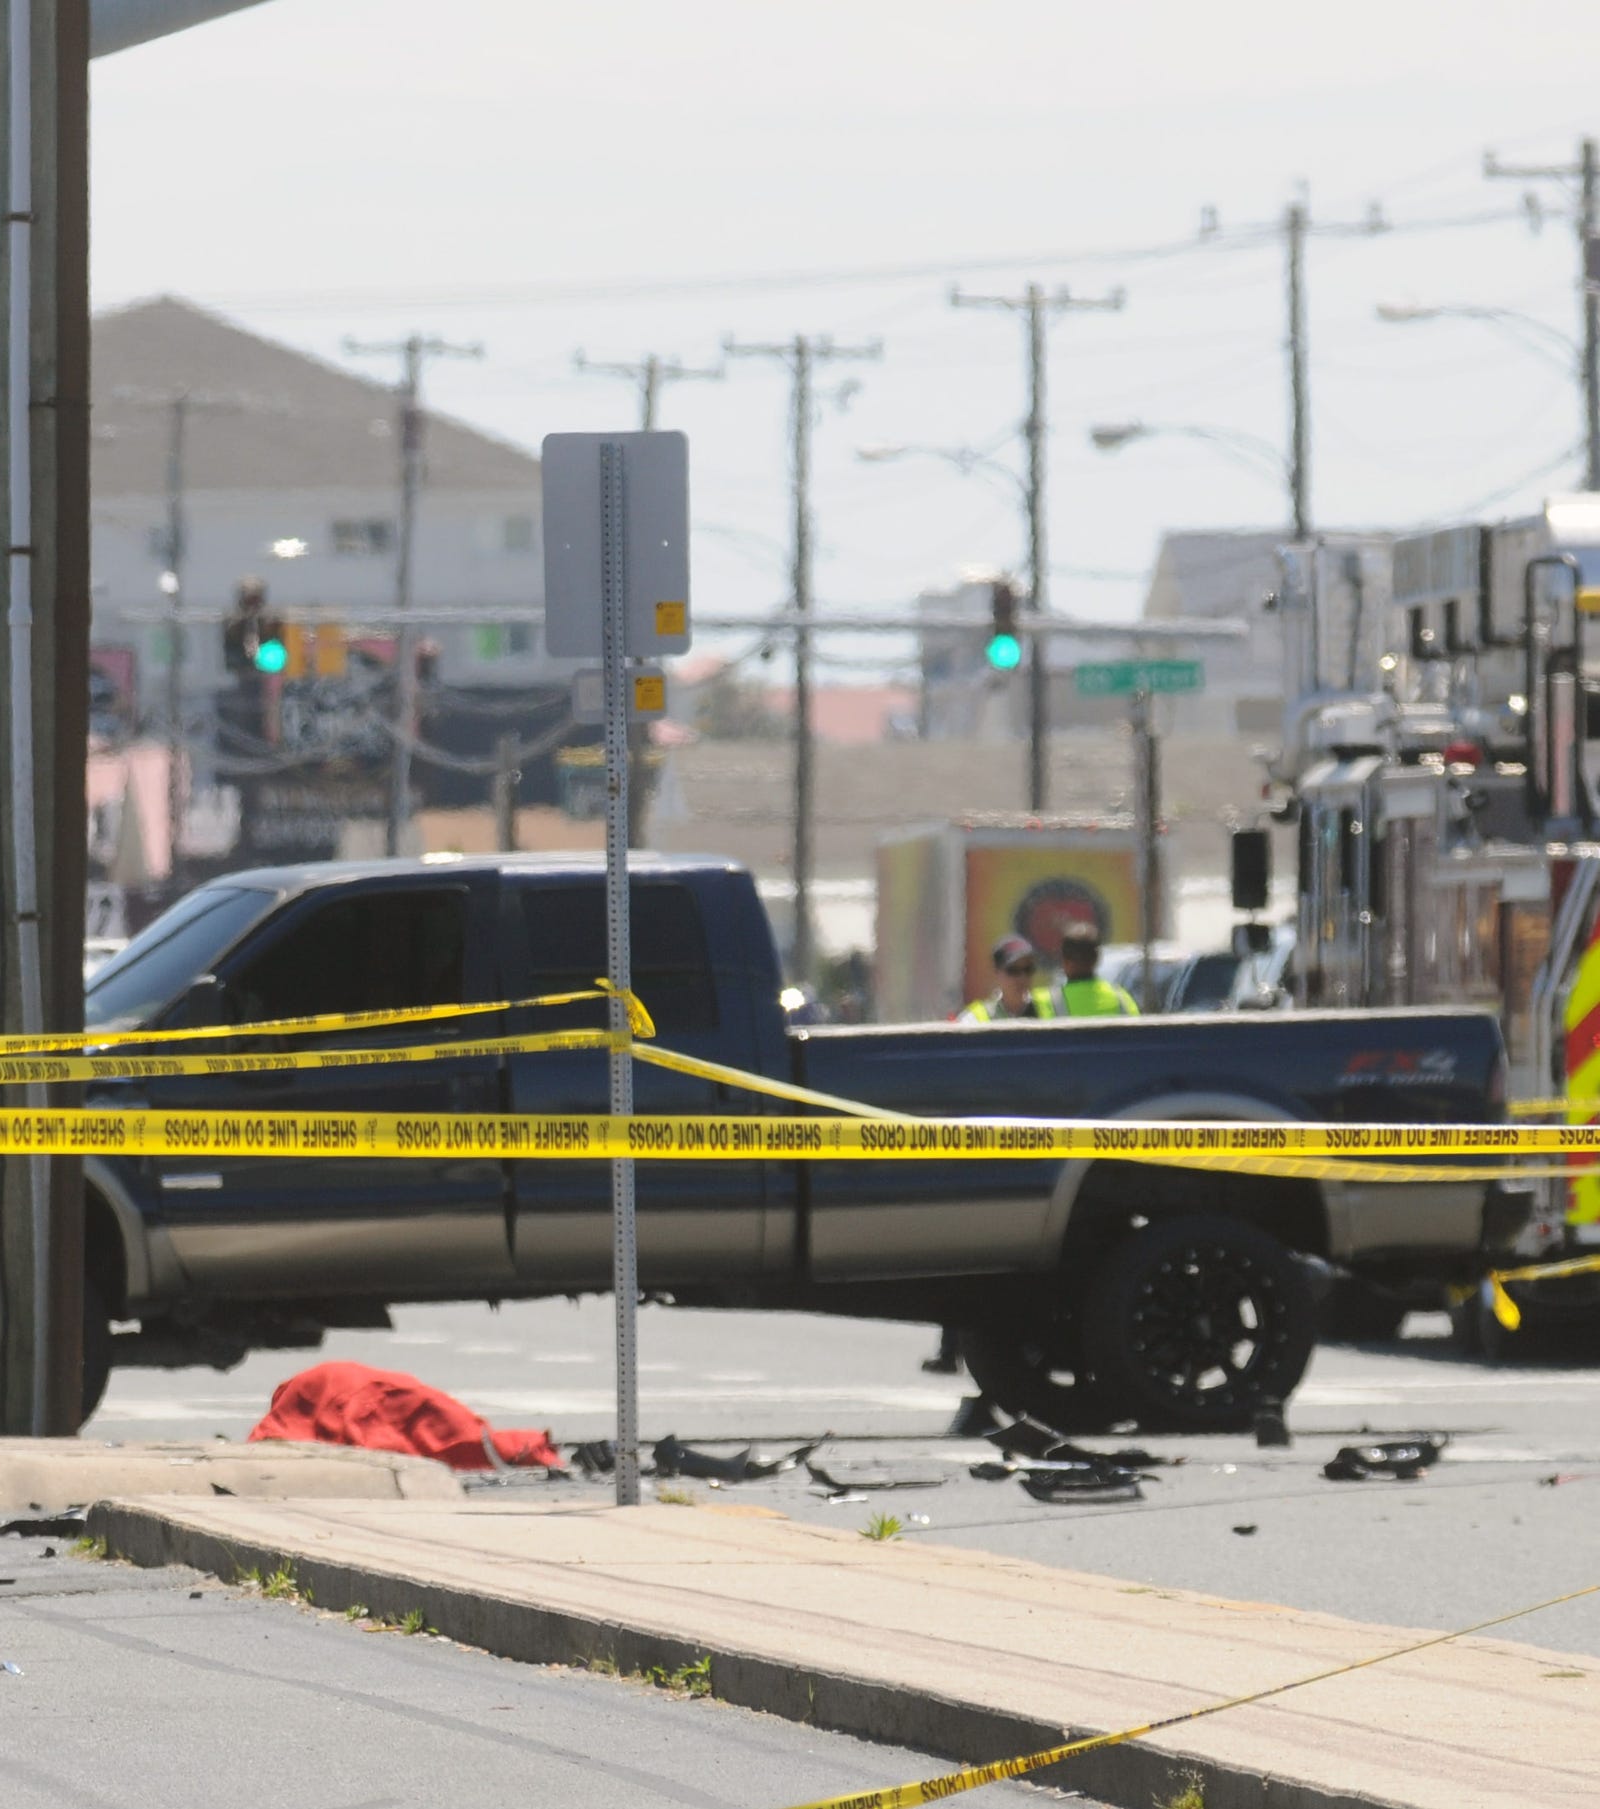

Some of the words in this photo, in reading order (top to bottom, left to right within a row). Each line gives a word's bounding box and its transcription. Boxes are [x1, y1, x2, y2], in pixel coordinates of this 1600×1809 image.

[14, 1116, 31, 1146] DO
[37, 1116, 66, 1146] LINE
[71, 1116, 126, 1146] SHERIFF
[164, 1119, 209, 1148] CROSS
[213, 1119, 241, 1148] NOT
[246, 1119, 264, 1148] DO
[269, 1119, 298, 1148] LINE
[303, 1119, 358, 1148] SHERIFF
[396, 1121, 441, 1149] CROSS
[445, 1121, 472, 1149] NOT
[478, 1121, 495, 1149] DO
[501, 1121, 530, 1149] LINE
[535, 1121, 590, 1149] SHERIFF
[628, 1123, 673, 1150] CROSS
[677, 1123, 704, 1150] NOT
[710, 1123, 728, 1150] DO
[733, 1123, 762, 1150] LINE
[767, 1123, 822, 1150] SHERIFF
[860, 1125, 905, 1151] CROSS
[909, 1125, 937, 1151] NOT
[942, 1125, 960, 1151] DO
[966, 1125, 994, 1151] LINE
[1000, 1125, 1054, 1151] SHERIFF
[1094, 1128, 1138, 1150] CROSS
[1142, 1128, 1170, 1150] NOT
[1175, 1128, 1193, 1150] DO
[1198, 1128, 1227, 1150] LINE
[1232, 1128, 1287, 1150] SHERIFF
